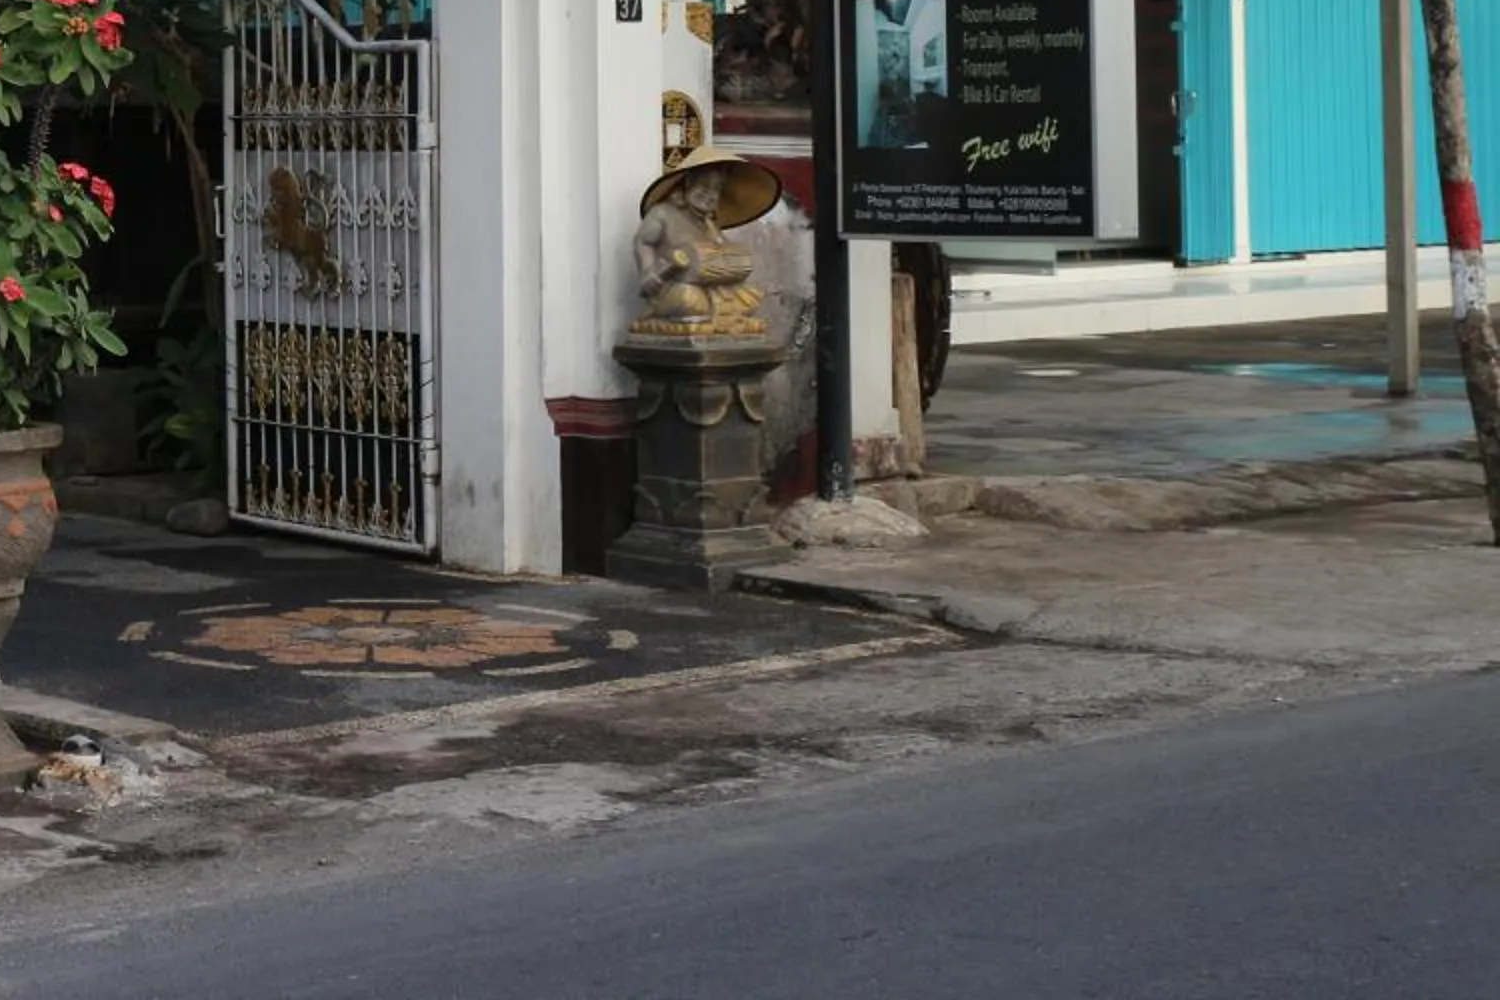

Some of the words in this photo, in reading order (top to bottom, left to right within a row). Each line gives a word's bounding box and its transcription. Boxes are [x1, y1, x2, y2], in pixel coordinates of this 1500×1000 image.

[1043, 26, 1085, 53] monthly
[1010, 83, 1042, 103] Rental
[961, 136, 1012, 173] Free
[1018, 116, 1060, 153] wifi
